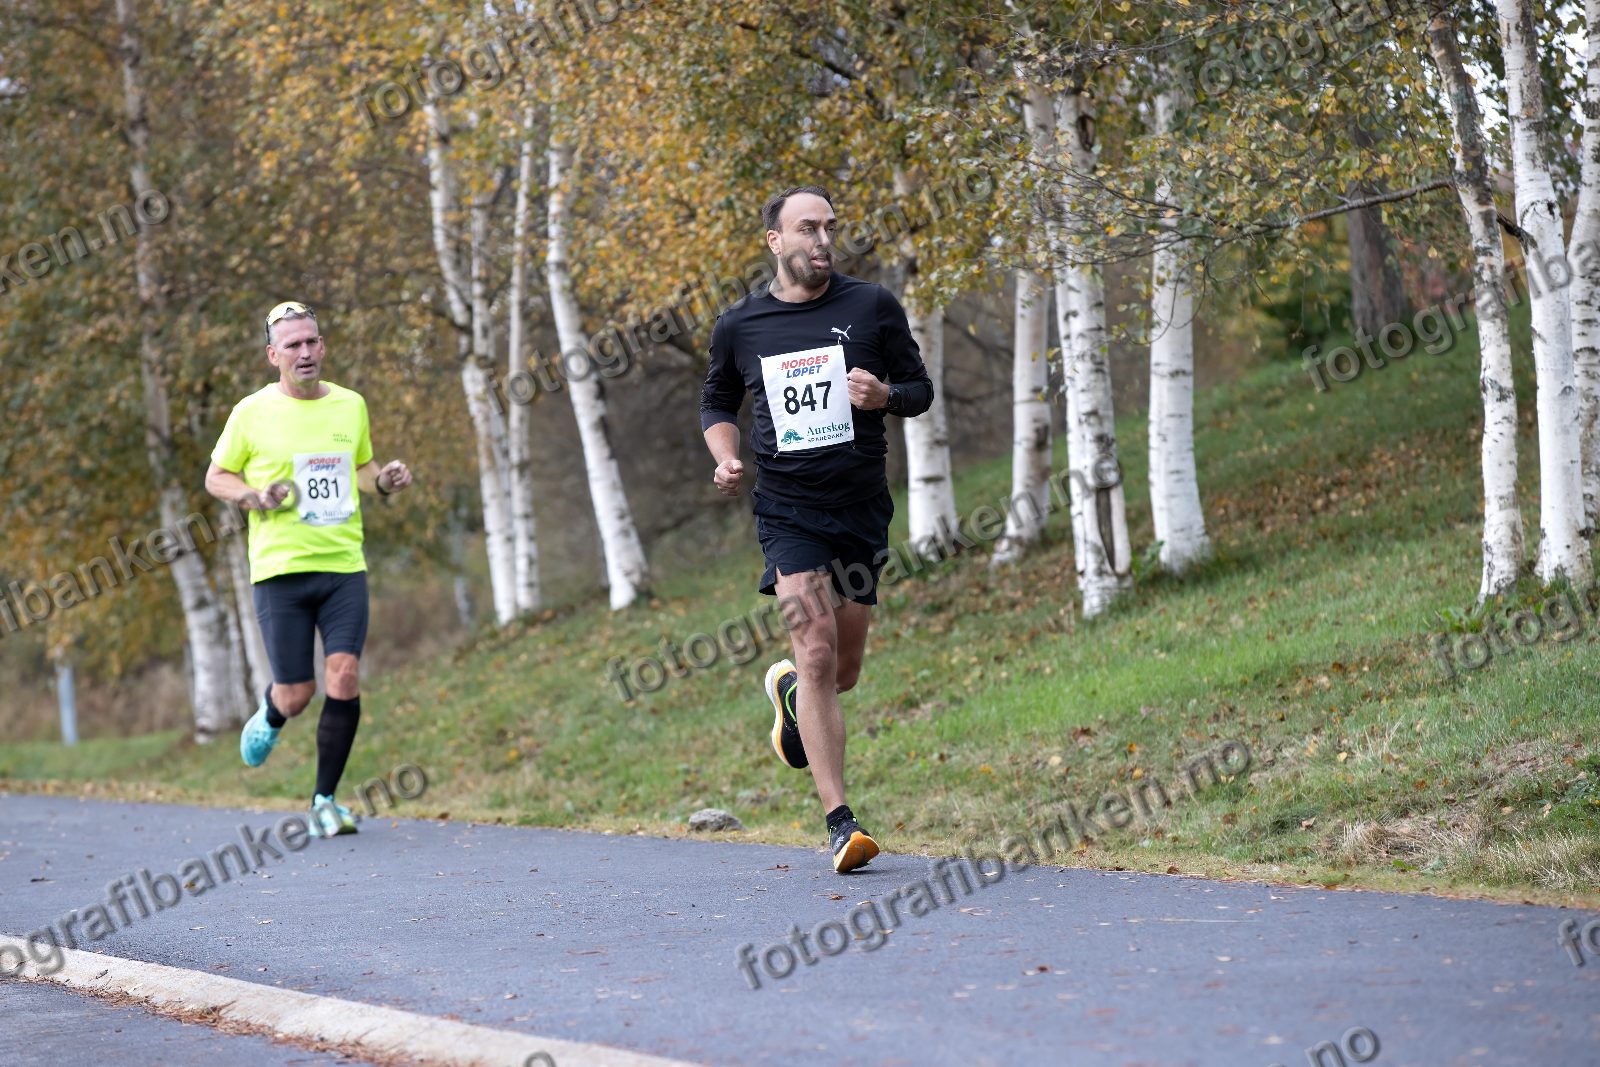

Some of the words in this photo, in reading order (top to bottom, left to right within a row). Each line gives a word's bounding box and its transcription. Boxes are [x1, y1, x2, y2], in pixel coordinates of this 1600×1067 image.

[781, 354, 830, 370] NORGES
[786, 364, 822, 379] LØPET
[783, 380, 832, 415] 847
[807, 420, 851, 437] Aurskog
[308, 477, 340, 499] 831
